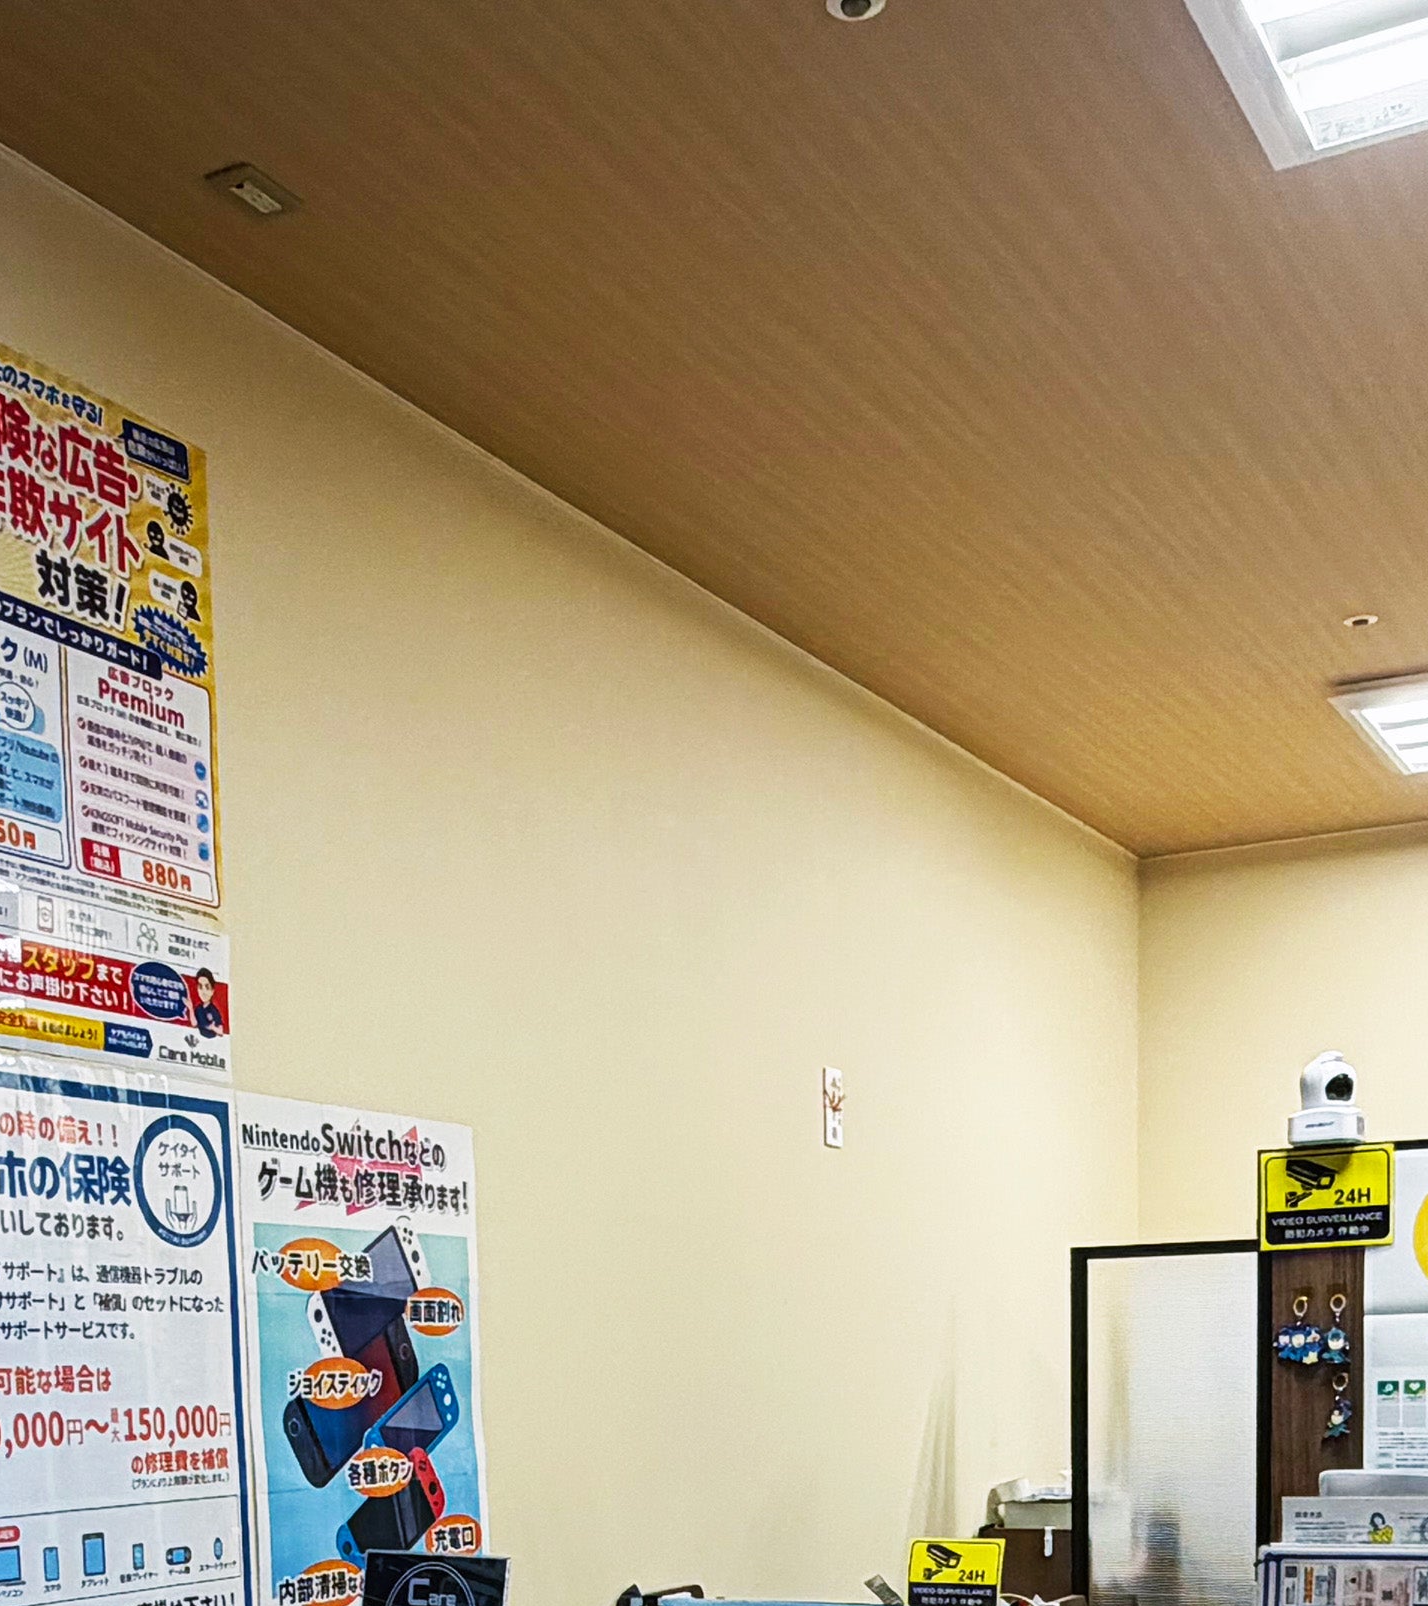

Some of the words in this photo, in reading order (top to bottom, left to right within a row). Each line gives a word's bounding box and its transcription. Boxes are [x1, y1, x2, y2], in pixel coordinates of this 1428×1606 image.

[108, 666, 174, 702] 広告ブロック
[98, 678, 186, 729] Premium
[142, 859, 192, 893] 880円
[158, 1045, 187, 1063] Care
[189, 1049, 226, 1068] Mobile
[157, 1141, 198, 1159] ケイタイ
[158, 1161, 200, 1179] サポート
[1333, 1187, 1372, 1205] 24H
[1272, 1216, 1304, 1227] VIDEO
[1305, 1211, 1383, 1225] SURVEILLANCE
[252, 1250, 371, 1279] バッテリー交換
[409, 1300, 461, 1323] 画面割れ
[289, 1371, 381, 1397] ジョイスティック
[131, 1447, 230, 1474] の修理費を補償
[347, 1458, 412, 1487] 各種ボタン
[434, 1526, 474, 1552] 充電口
[957, 1569, 986, 1583] 24H
[408, 1578, 457, 1606] Care
